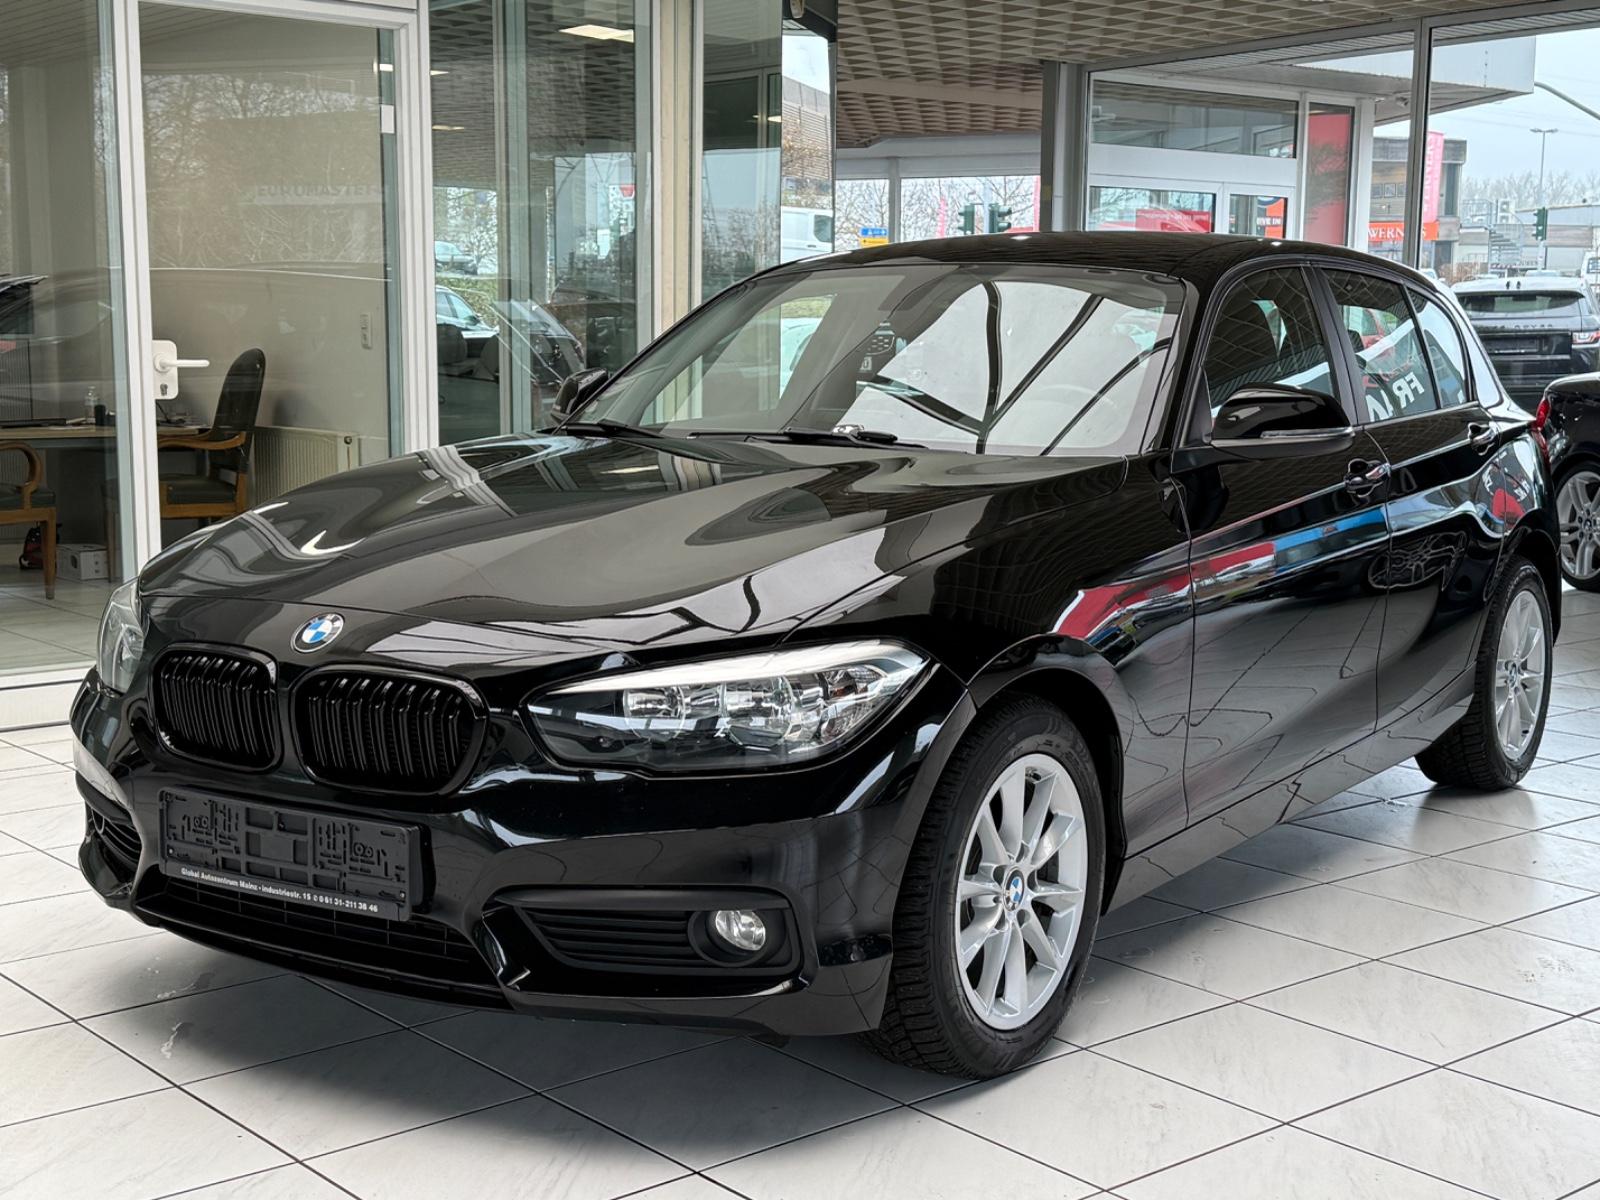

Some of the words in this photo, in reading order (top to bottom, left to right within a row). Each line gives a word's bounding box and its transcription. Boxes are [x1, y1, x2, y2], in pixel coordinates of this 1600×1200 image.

[181, 867, 200, 878] Global
[201, 872, 239, 886] Autozentrum
[240, 880, 258, 891] Mainz
